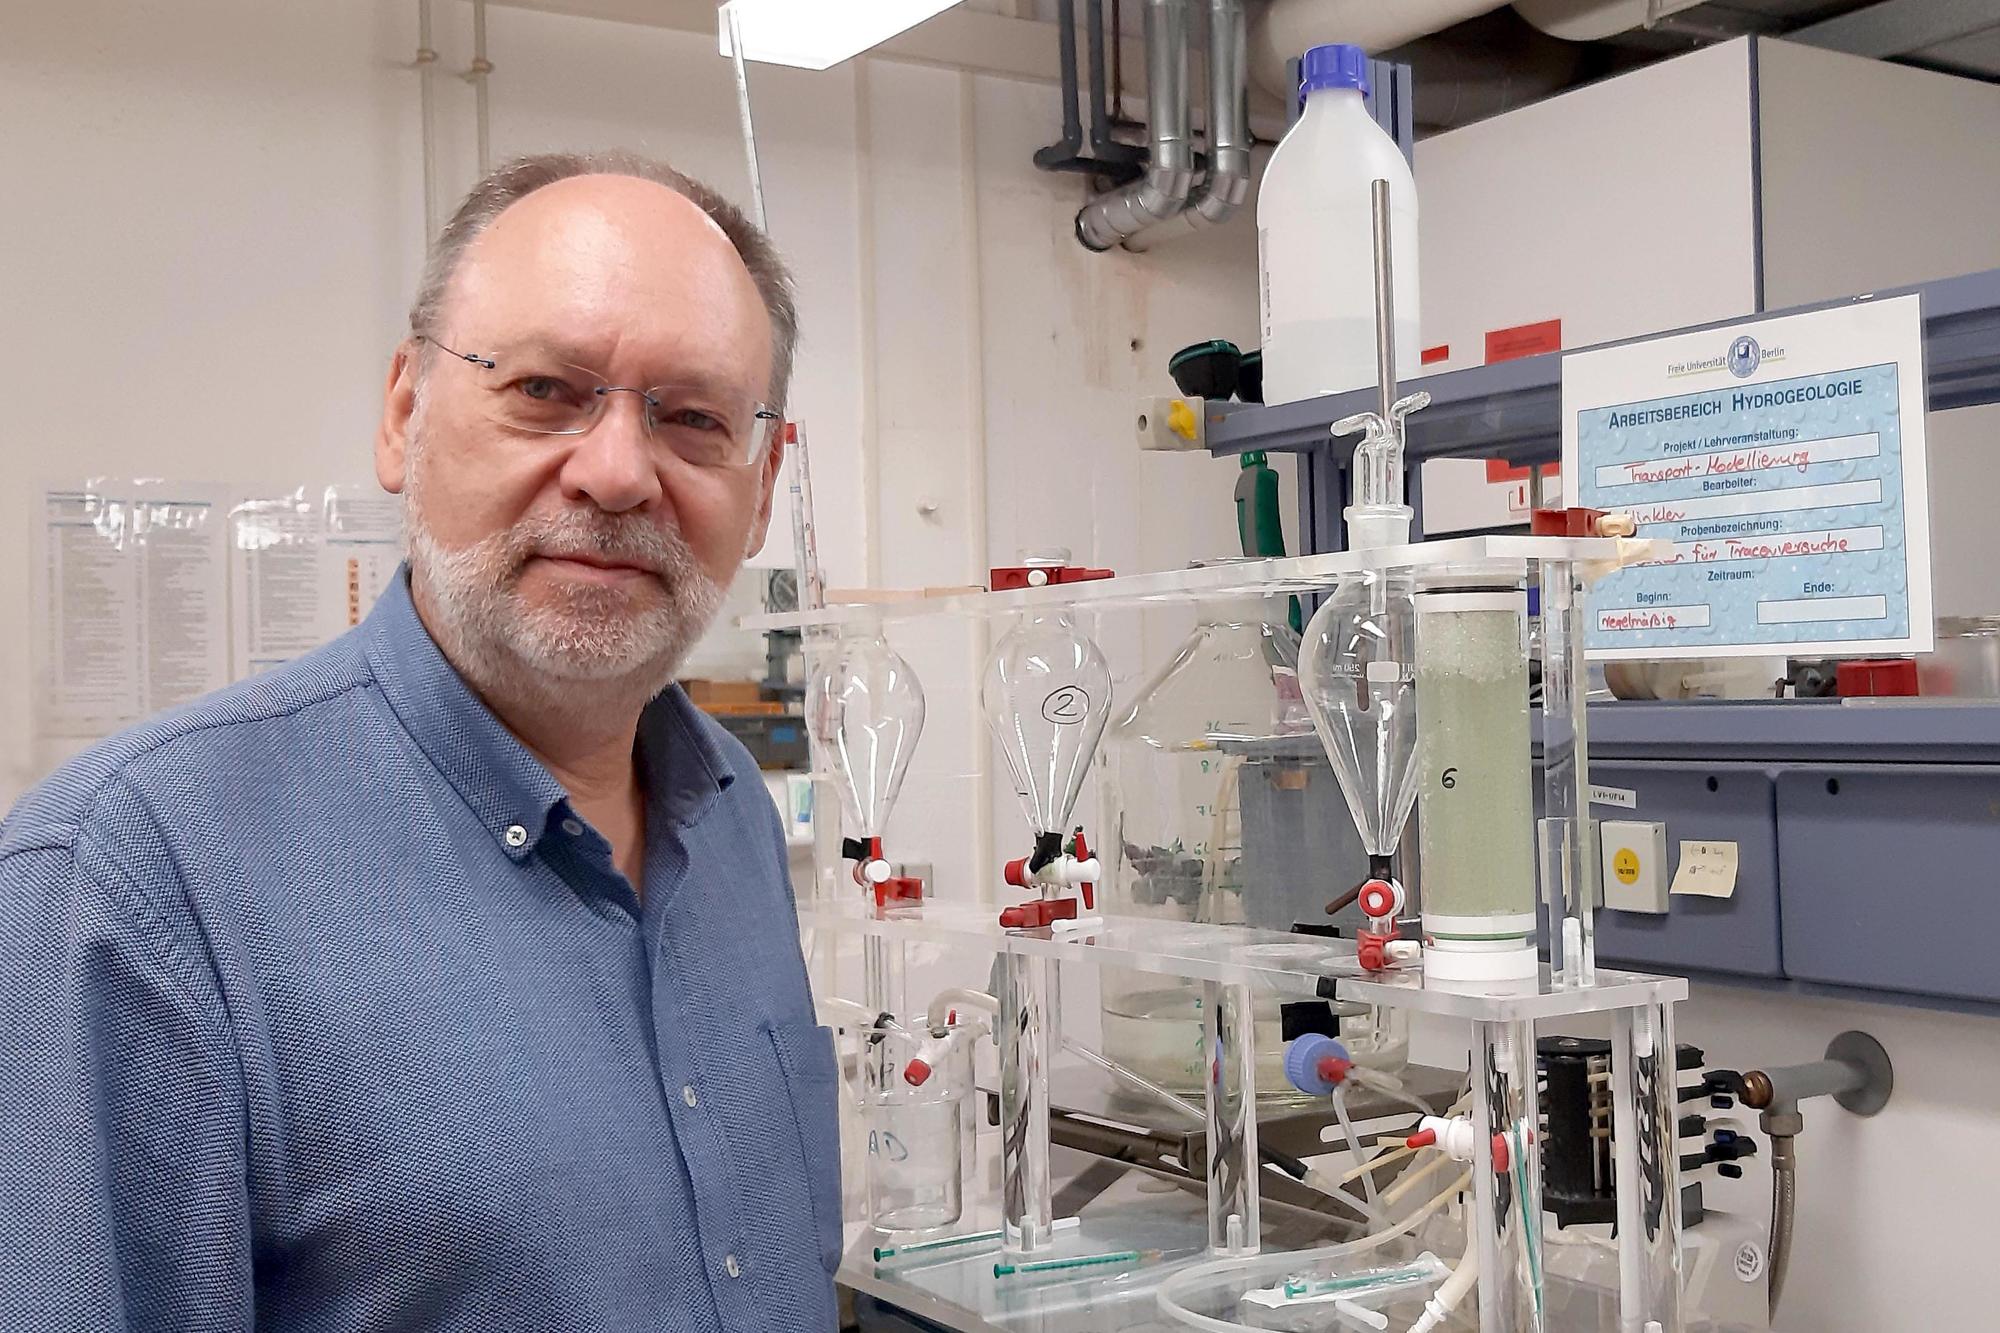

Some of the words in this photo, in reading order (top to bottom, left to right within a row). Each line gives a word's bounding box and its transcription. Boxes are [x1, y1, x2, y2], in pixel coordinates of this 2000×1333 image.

[1667, 363, 1685, 374] Freie
[1686, 357, 1727, 372] Universität
[1760, 347, 1785, 359] Berlin
[1663, 440, 1696, 454] Projekt
[1704, 427, 1799, 448] Lehrveranstaltung:
[1702, 477, 1757, 491] Bearbeiter:
[1680, 519, 1783, 537] Probenbezeichnung:
[1692, 543, 1718, 563] für
[1707, 570, 1755, 582] Zeitraum:
[1636, 592, 1672, 604] Beginn:
[1803, 582, 1835, 593] Ende:
[1053, 693, 1077, 716] 2
[1441, 767, 1458, 789] 6
